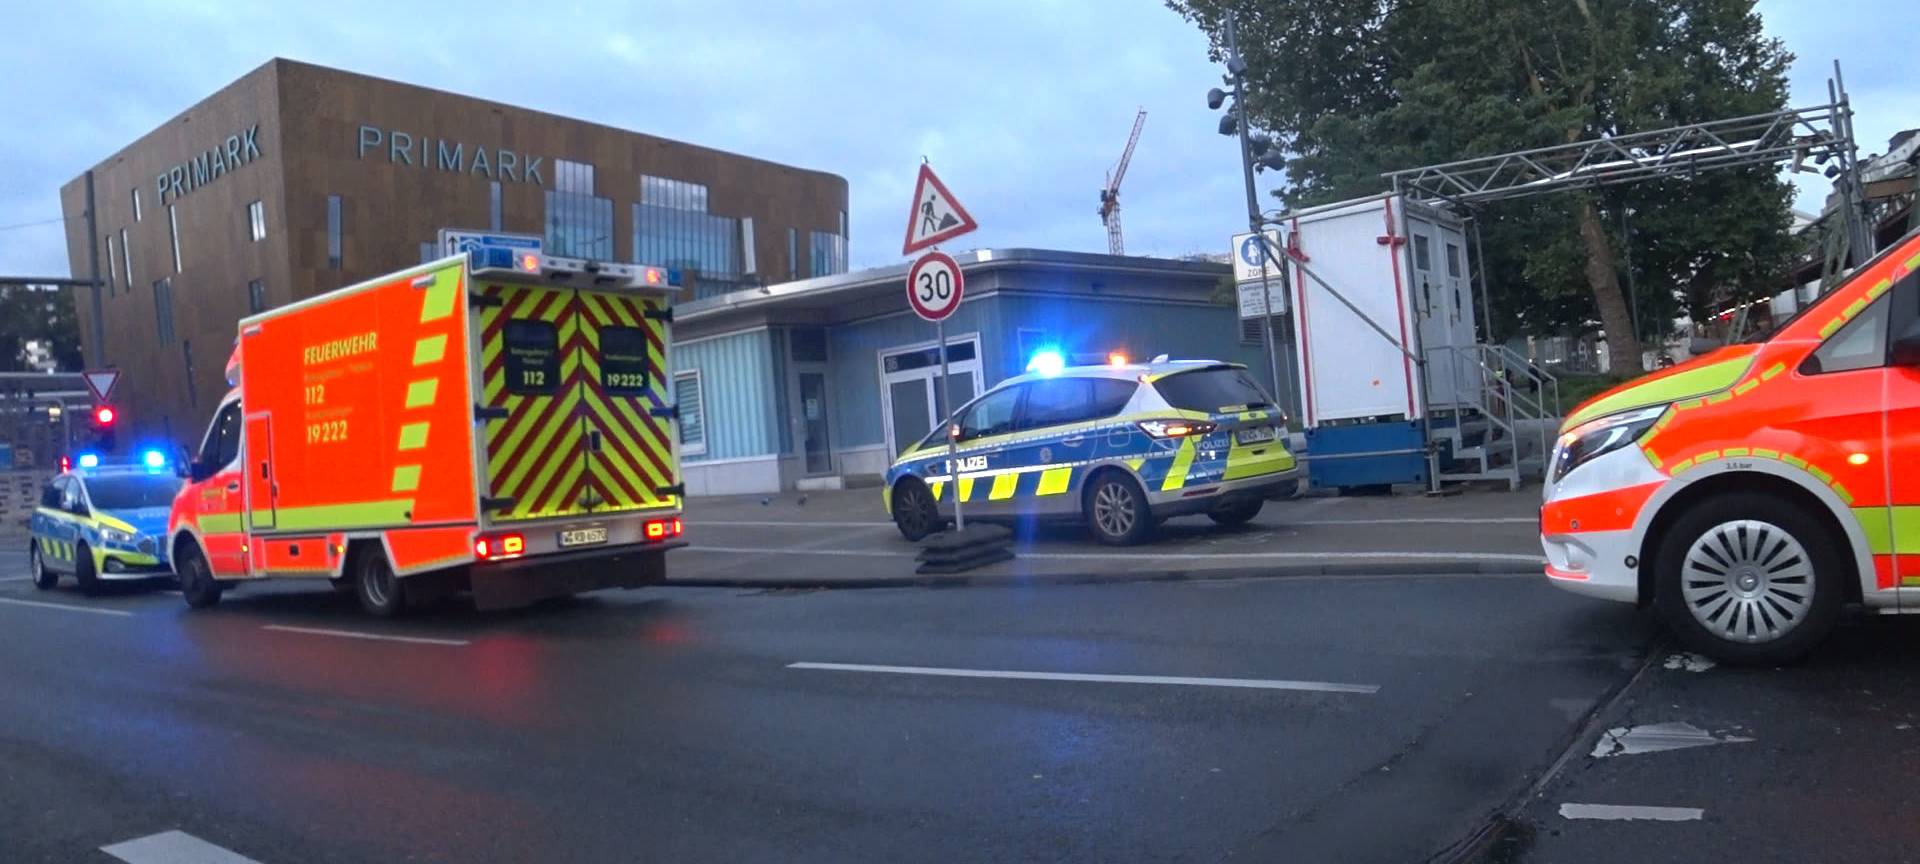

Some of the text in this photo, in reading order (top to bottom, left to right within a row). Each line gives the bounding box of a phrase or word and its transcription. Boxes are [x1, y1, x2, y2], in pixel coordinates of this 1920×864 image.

[157, 123, 261, 206] PRIMARK
[359, 125, 544, 185] PRIMARK
[1247, 267, 1271, 278] ZONE
[920, 270, 950, 302] 30
[303, 332, 377, 365] FEUERWEHR
[523, 370, 545, 385] 112
[305, 384, 324, 405] 112
[1196, 439, 1229, 450] POLIZEI
